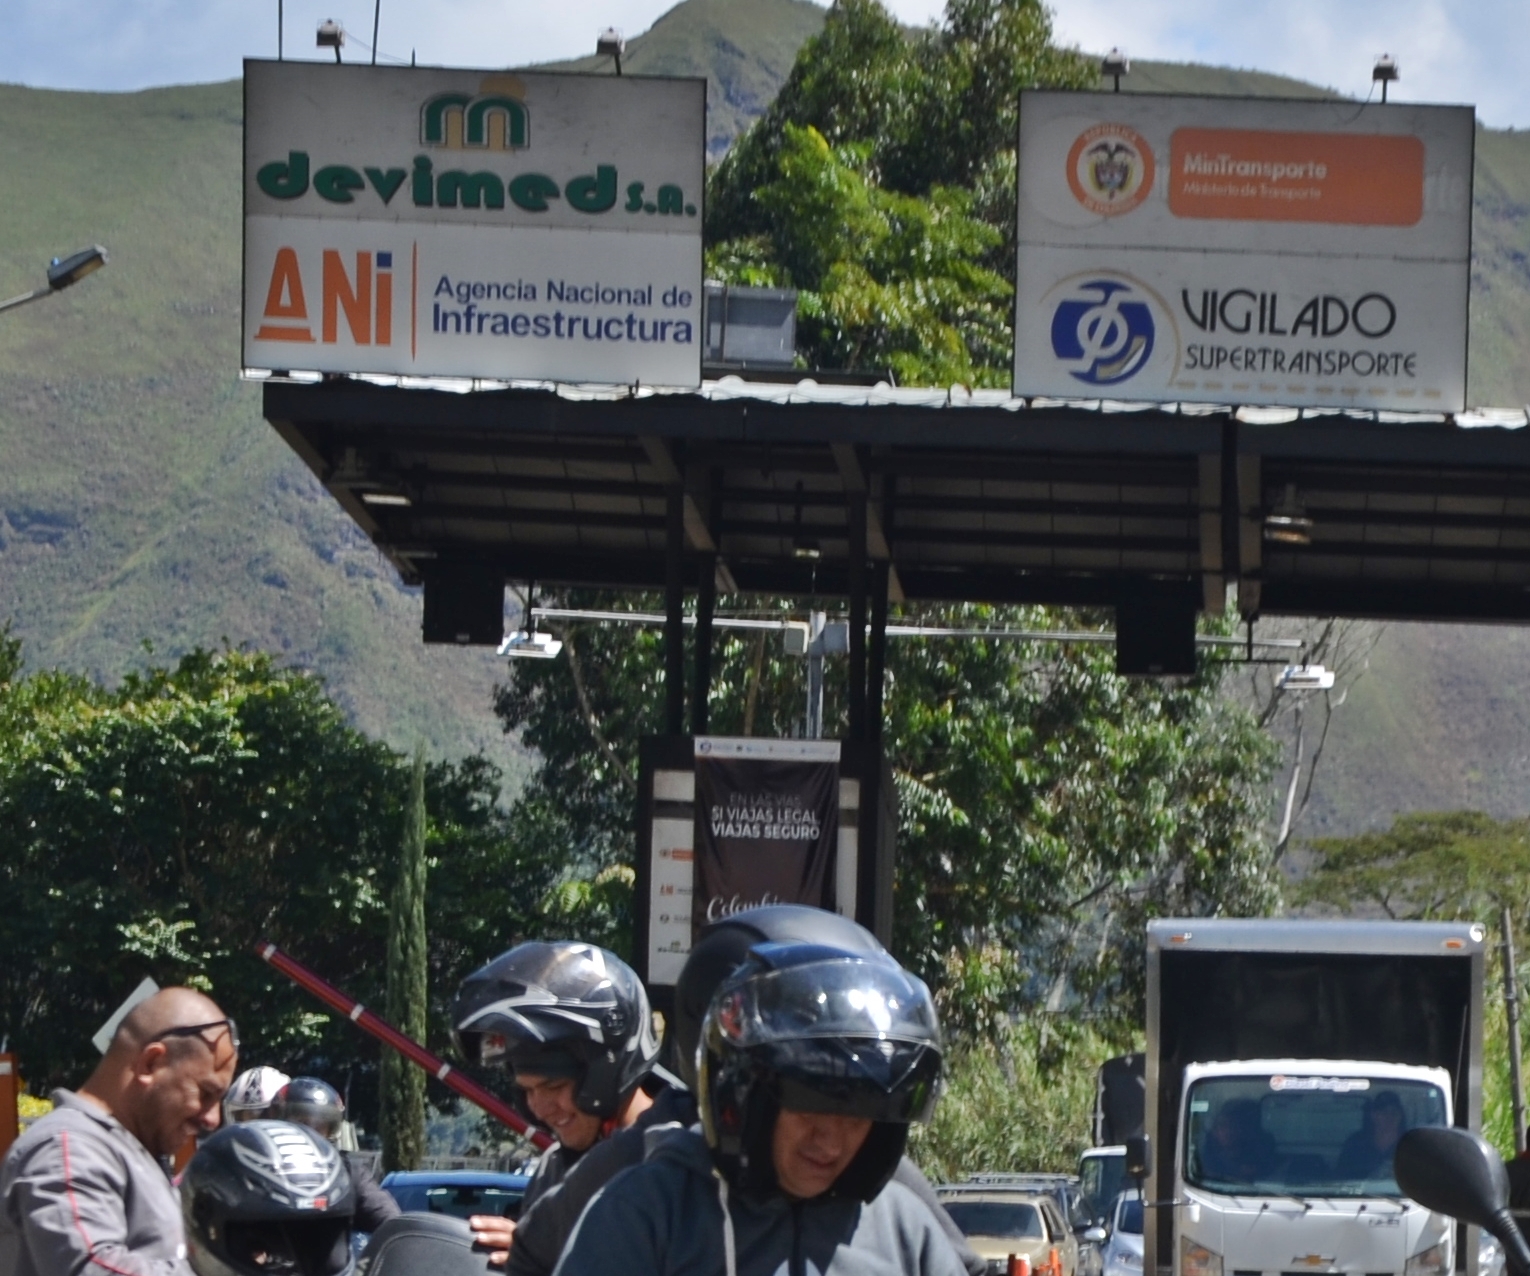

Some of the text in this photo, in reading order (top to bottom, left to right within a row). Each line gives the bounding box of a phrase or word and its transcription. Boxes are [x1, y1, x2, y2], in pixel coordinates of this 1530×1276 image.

[257, 151, 617, 213] devimed
[1184, 153, 1327, 182] MinTransporte
[435, 275, 692, 308] Agencia Nacional de
[433, 303, 692, 344] Infraestructura
[1181, 288, 1396, 338] VIGILADO
[1186, 345, 1417, 377] SUPERTRANSPORTE
[711, 805, 723, 821] SI
[726, 807, 773, 823] VIAJAS
[712, 822, 820, 840] VIAJAS SEGURO
